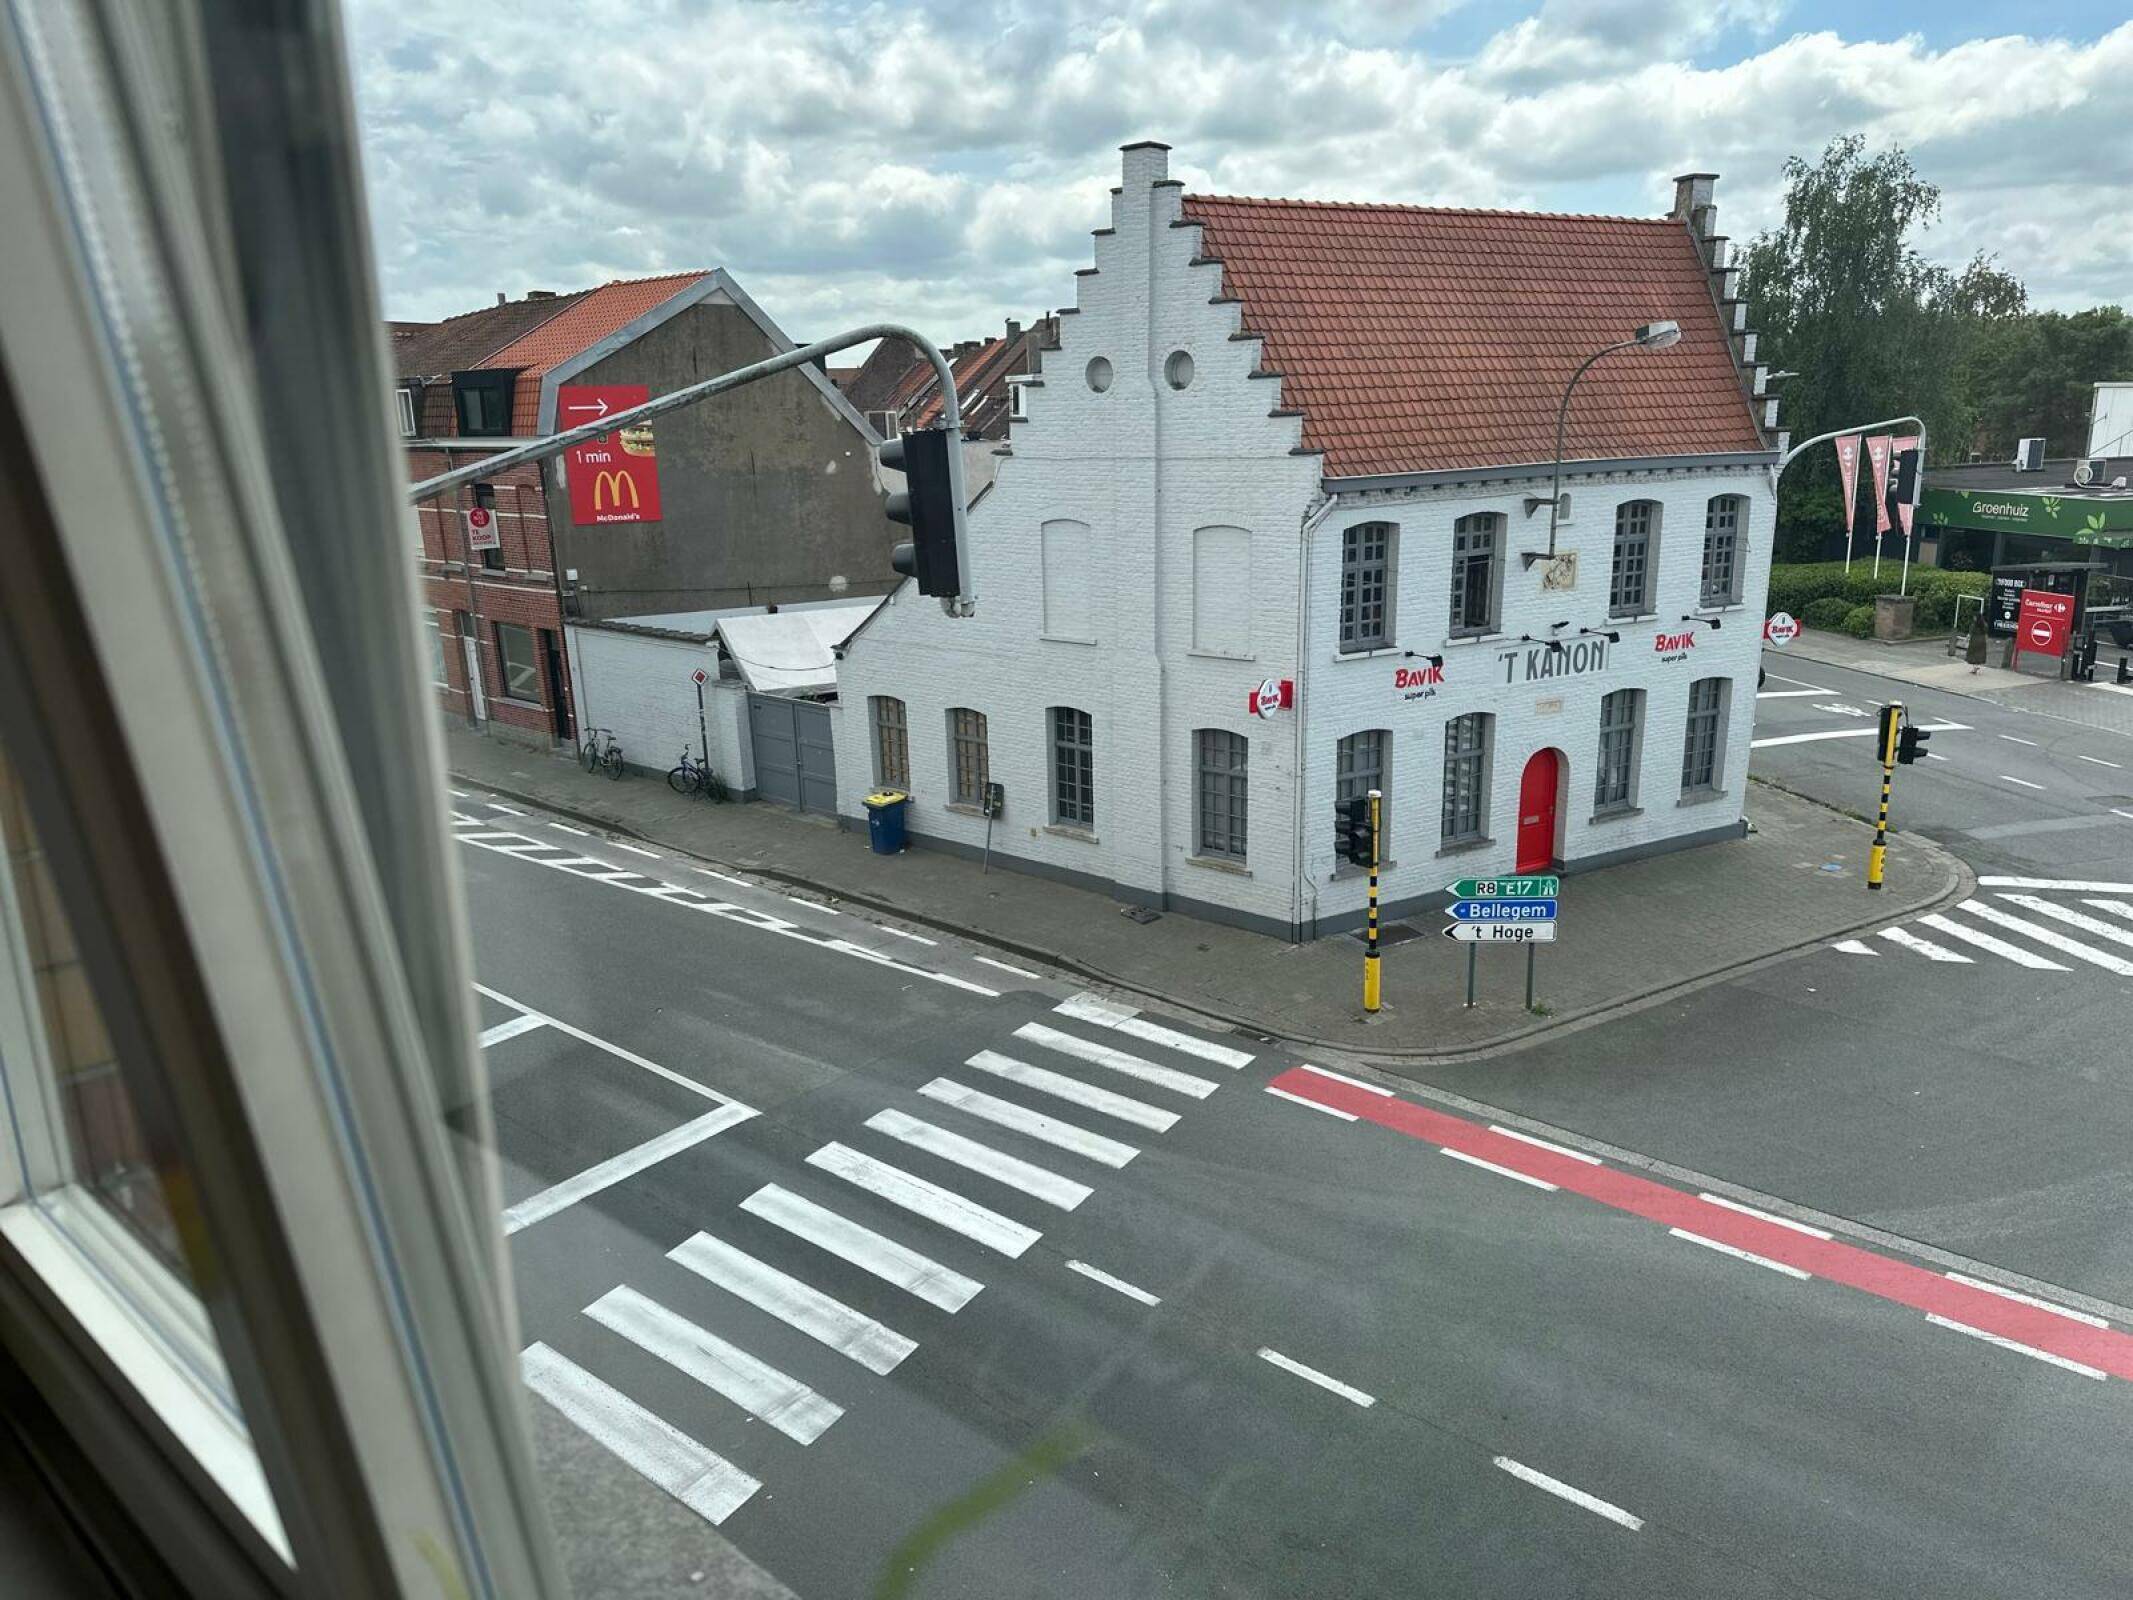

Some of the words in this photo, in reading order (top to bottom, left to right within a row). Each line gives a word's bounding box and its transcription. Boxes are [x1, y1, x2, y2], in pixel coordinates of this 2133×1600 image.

[576, 450, 582, 464] 1
[585, 450, 612, 463] min
[596, 513, 640, 521] McDonald's
[1972, 501, 2030, 517] Groenhuiz
[2024, 598, 2054, 609] Carrefour
[1655, 631, 1695, 652] BAVIK
[1498, 652, 1518, 683] 'T
[1526, 640, 1604, 681] KANON
[1395, 667, 1445, 688] BAVIK
[1476, 882, 1496, 894] R8
[1506, 881, 1533, 895] E17
[1469, 903, 1546, 920] Bellegem
[1471, 925, 1482, 939] 't
[1492, 925, 1534, 942] Hoge
